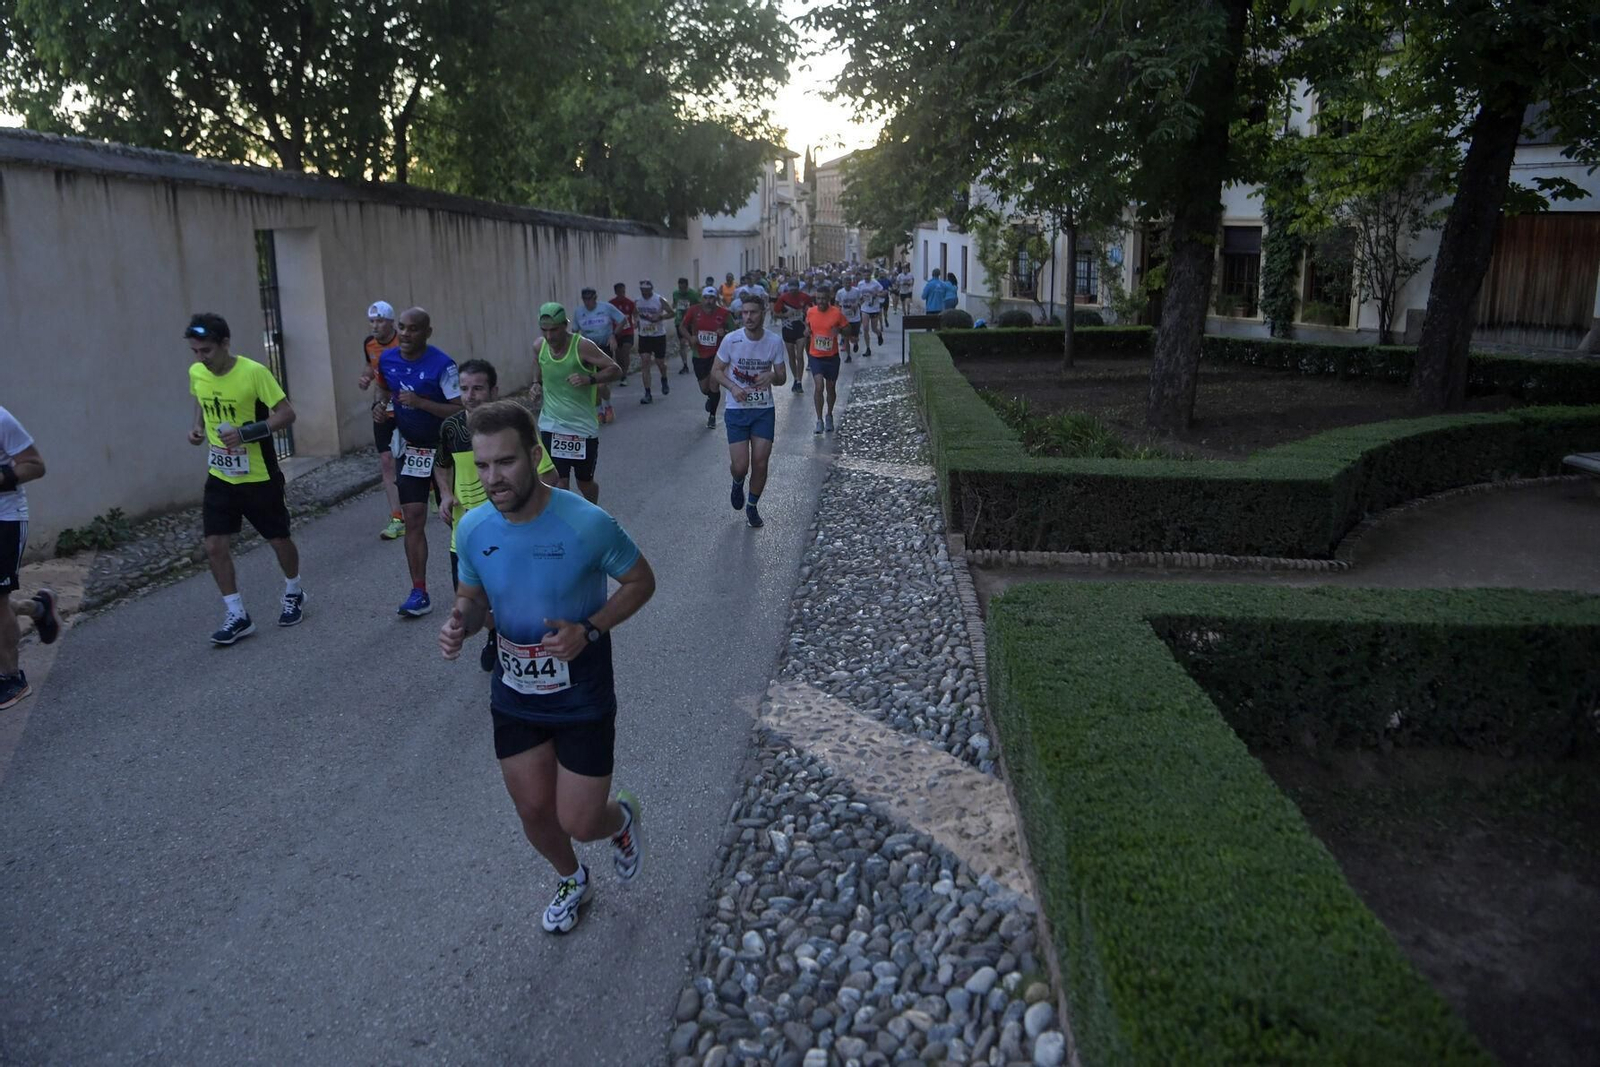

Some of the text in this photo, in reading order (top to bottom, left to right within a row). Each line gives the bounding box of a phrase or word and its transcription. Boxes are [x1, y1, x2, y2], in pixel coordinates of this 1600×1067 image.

[553, 440, 581, 452] 2590
[211, 453, 241, 467] 2881
[502, 652, 557, 679] 5344
